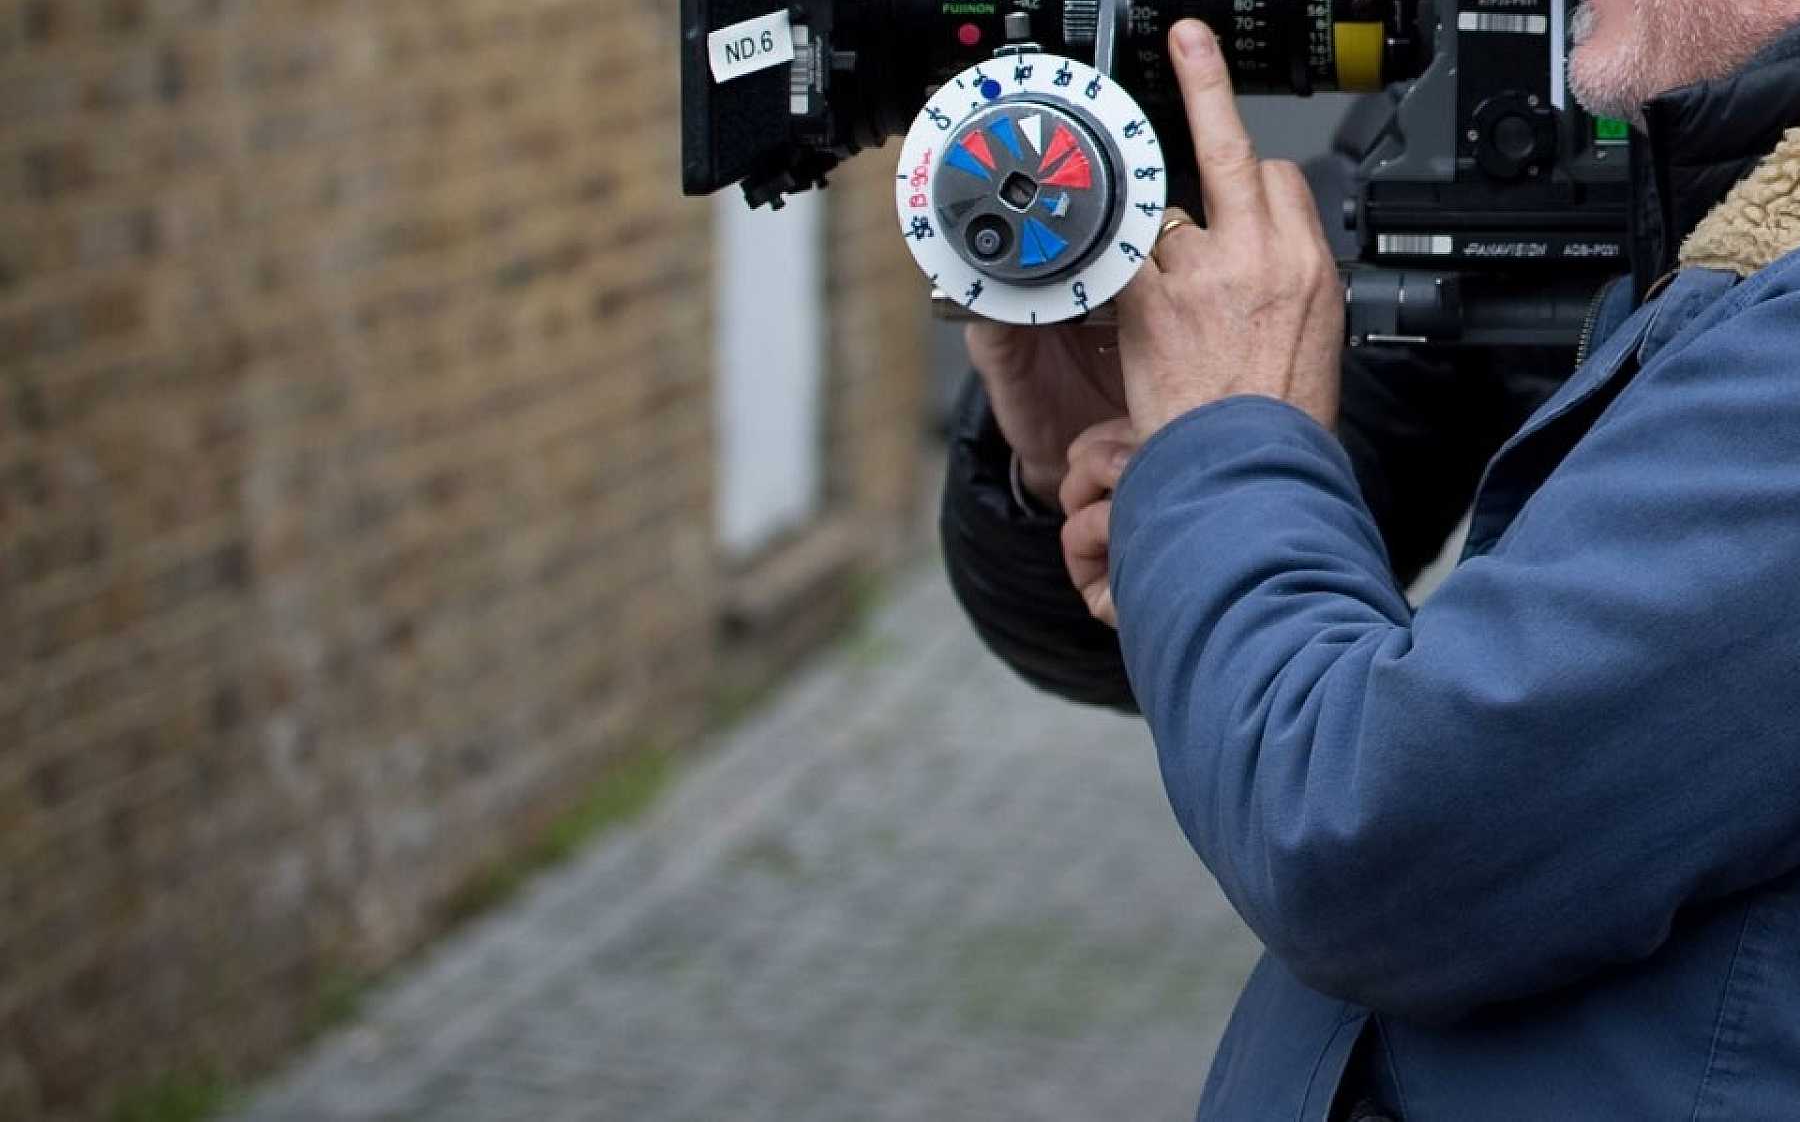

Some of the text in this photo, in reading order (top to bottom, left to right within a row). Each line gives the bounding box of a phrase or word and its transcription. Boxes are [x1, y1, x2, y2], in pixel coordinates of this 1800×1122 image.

[942, 2, 995, 14] FUJINON
[1234, 16, 1254, 30] 70
[725, 31, 773, 64] ND.6
[1235, 37, 1255, 50] 60
[1463, 242, 1548, 257] PANAVISION
